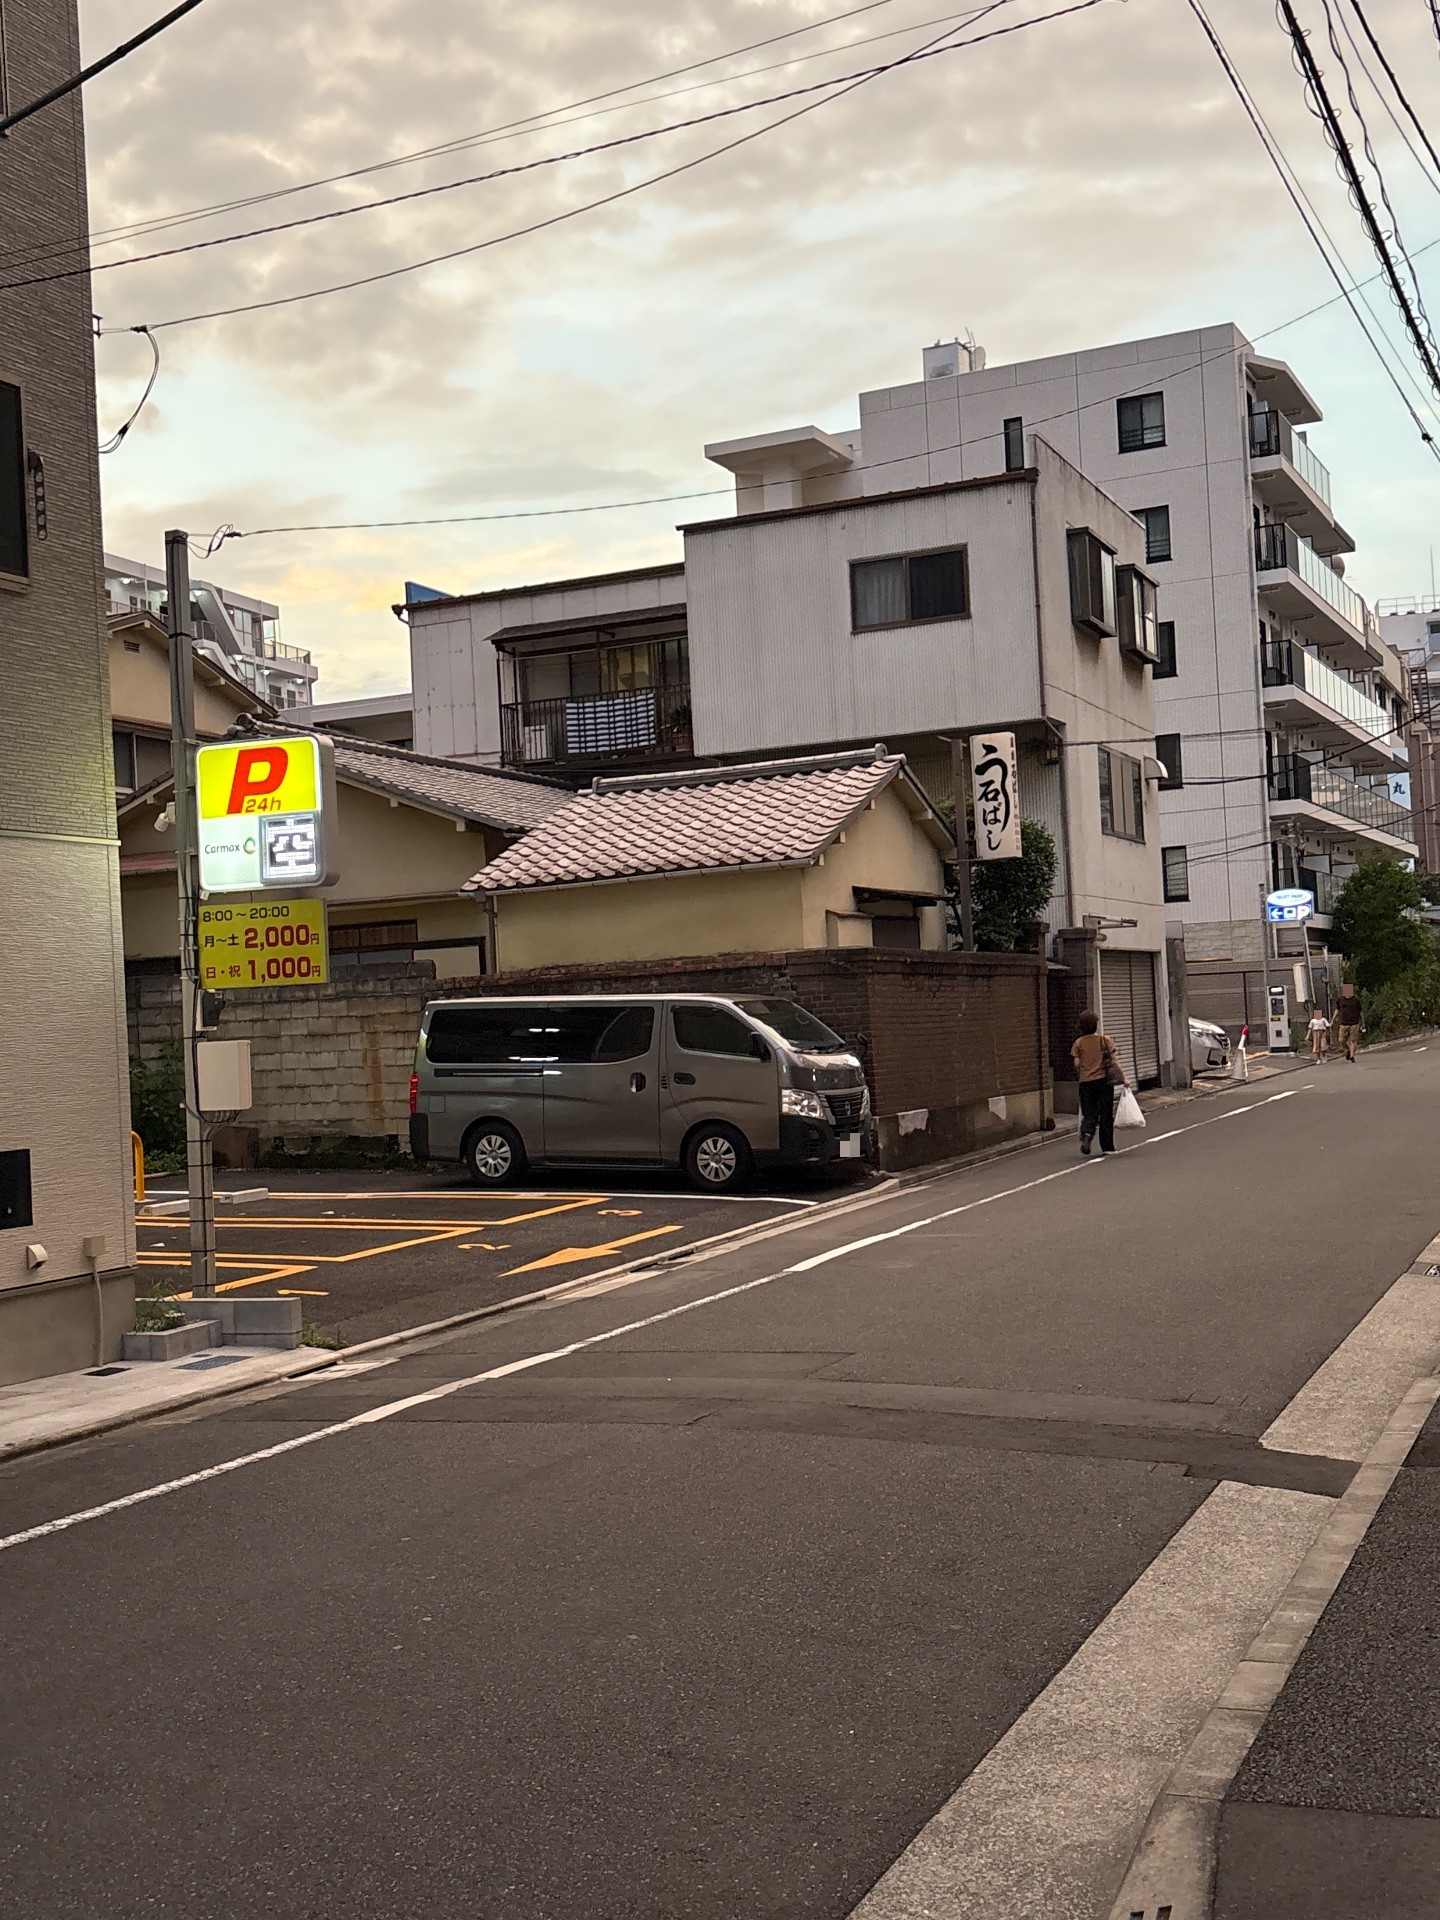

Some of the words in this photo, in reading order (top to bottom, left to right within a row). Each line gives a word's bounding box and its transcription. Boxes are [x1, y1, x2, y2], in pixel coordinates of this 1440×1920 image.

[227, 746, 289, 815] P
[1392, 781, 1405, 795] 丸
[245, 797, 281, 813] 24h
[204, 843, 240, 854] Carmax
[1297, 905, 1310, 920] P
[244, 924, 320, 951] 2,000円
[247, 956, 321, 983] 1,000円
